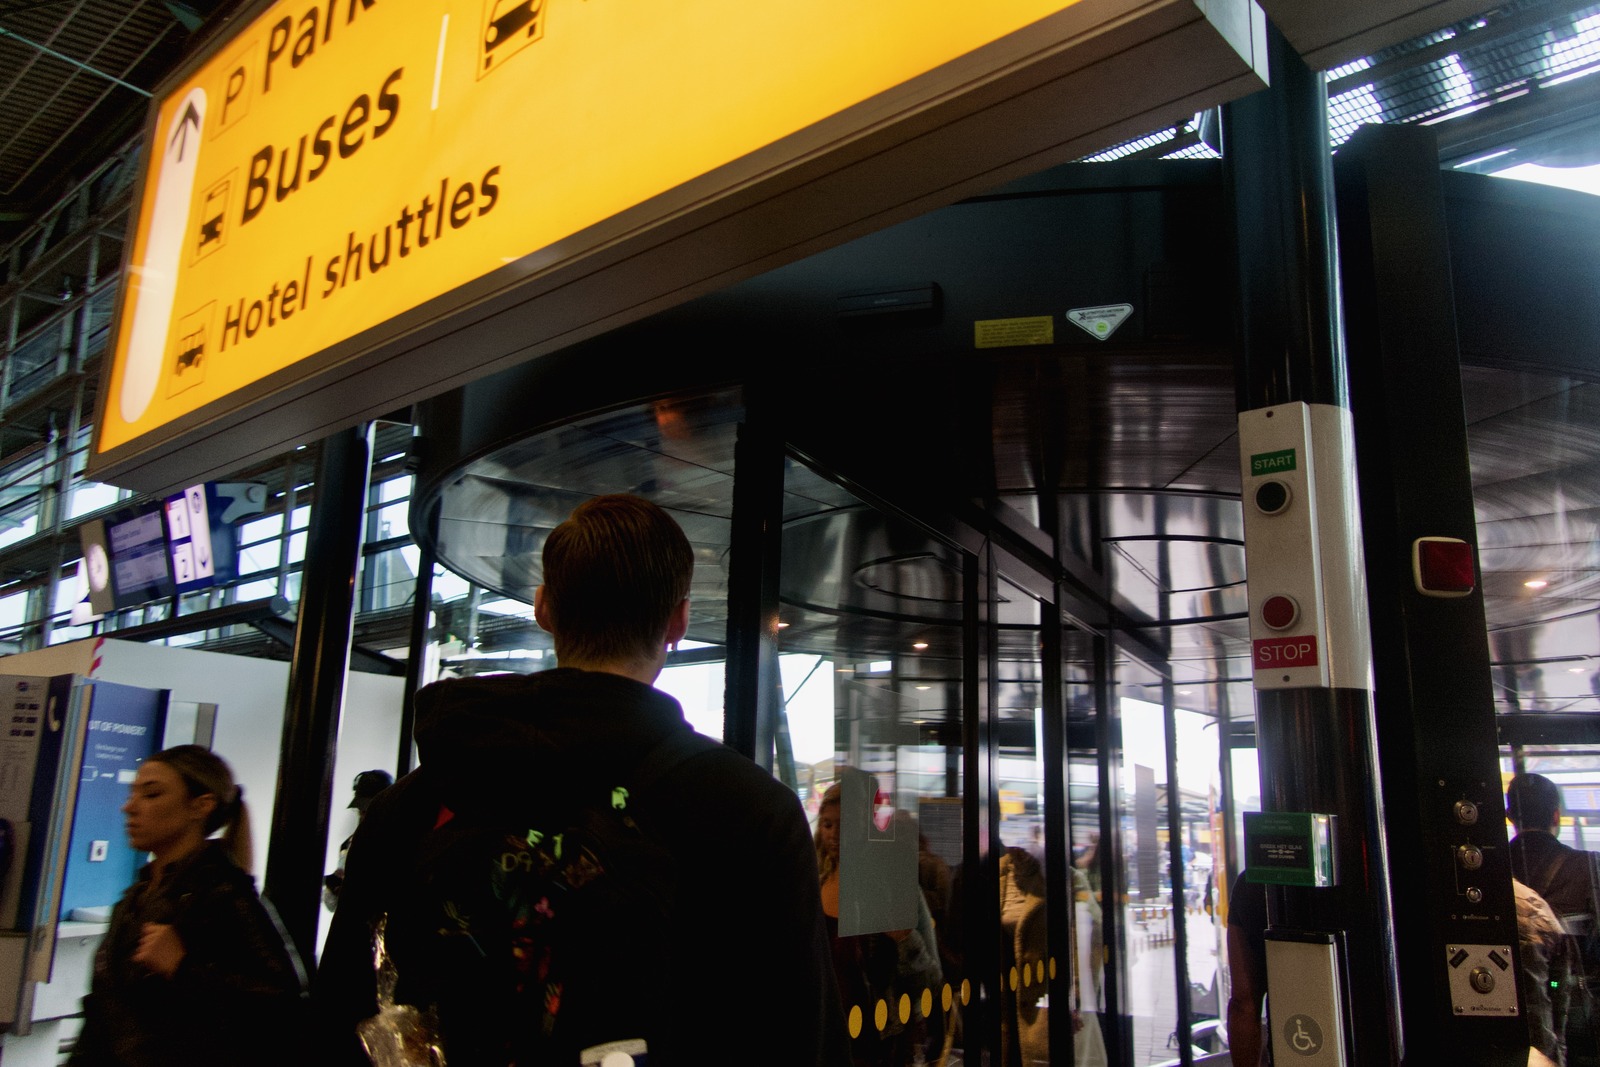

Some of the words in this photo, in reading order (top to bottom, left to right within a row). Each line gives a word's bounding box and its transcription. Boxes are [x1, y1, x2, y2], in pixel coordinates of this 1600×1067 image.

[240, 67, 404, 227] Buses
[219, 256, 313, 353] Hotel
[321, 165, 501, 299] shuttles
[1254, 455, 1293, 470] START
[1259, 643, 1311, 662] STOP
